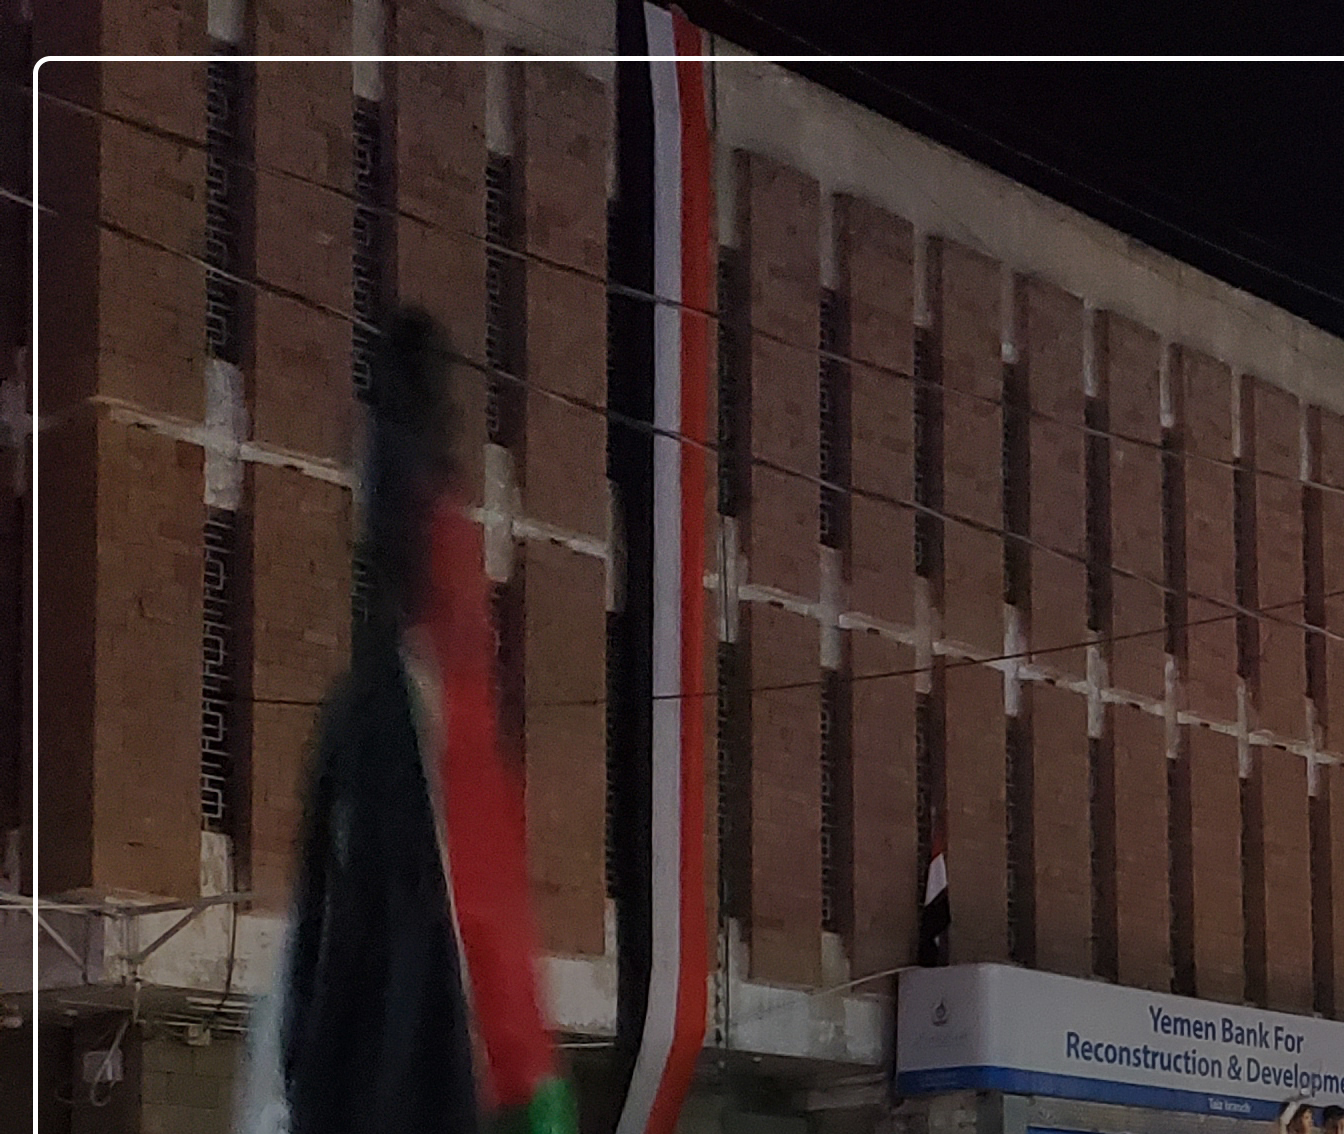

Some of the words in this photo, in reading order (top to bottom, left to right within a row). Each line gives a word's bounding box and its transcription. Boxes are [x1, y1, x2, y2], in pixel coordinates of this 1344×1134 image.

[1149, 1004, 1216, 1041] Yemen
[1221, 1017, 1270, 1050] Bank
[1274, 1025, 1304, 1054] For
[1066, 1030, 1222, 1079] Reconstruction
[1227, 1055, 1242, 1081] &
